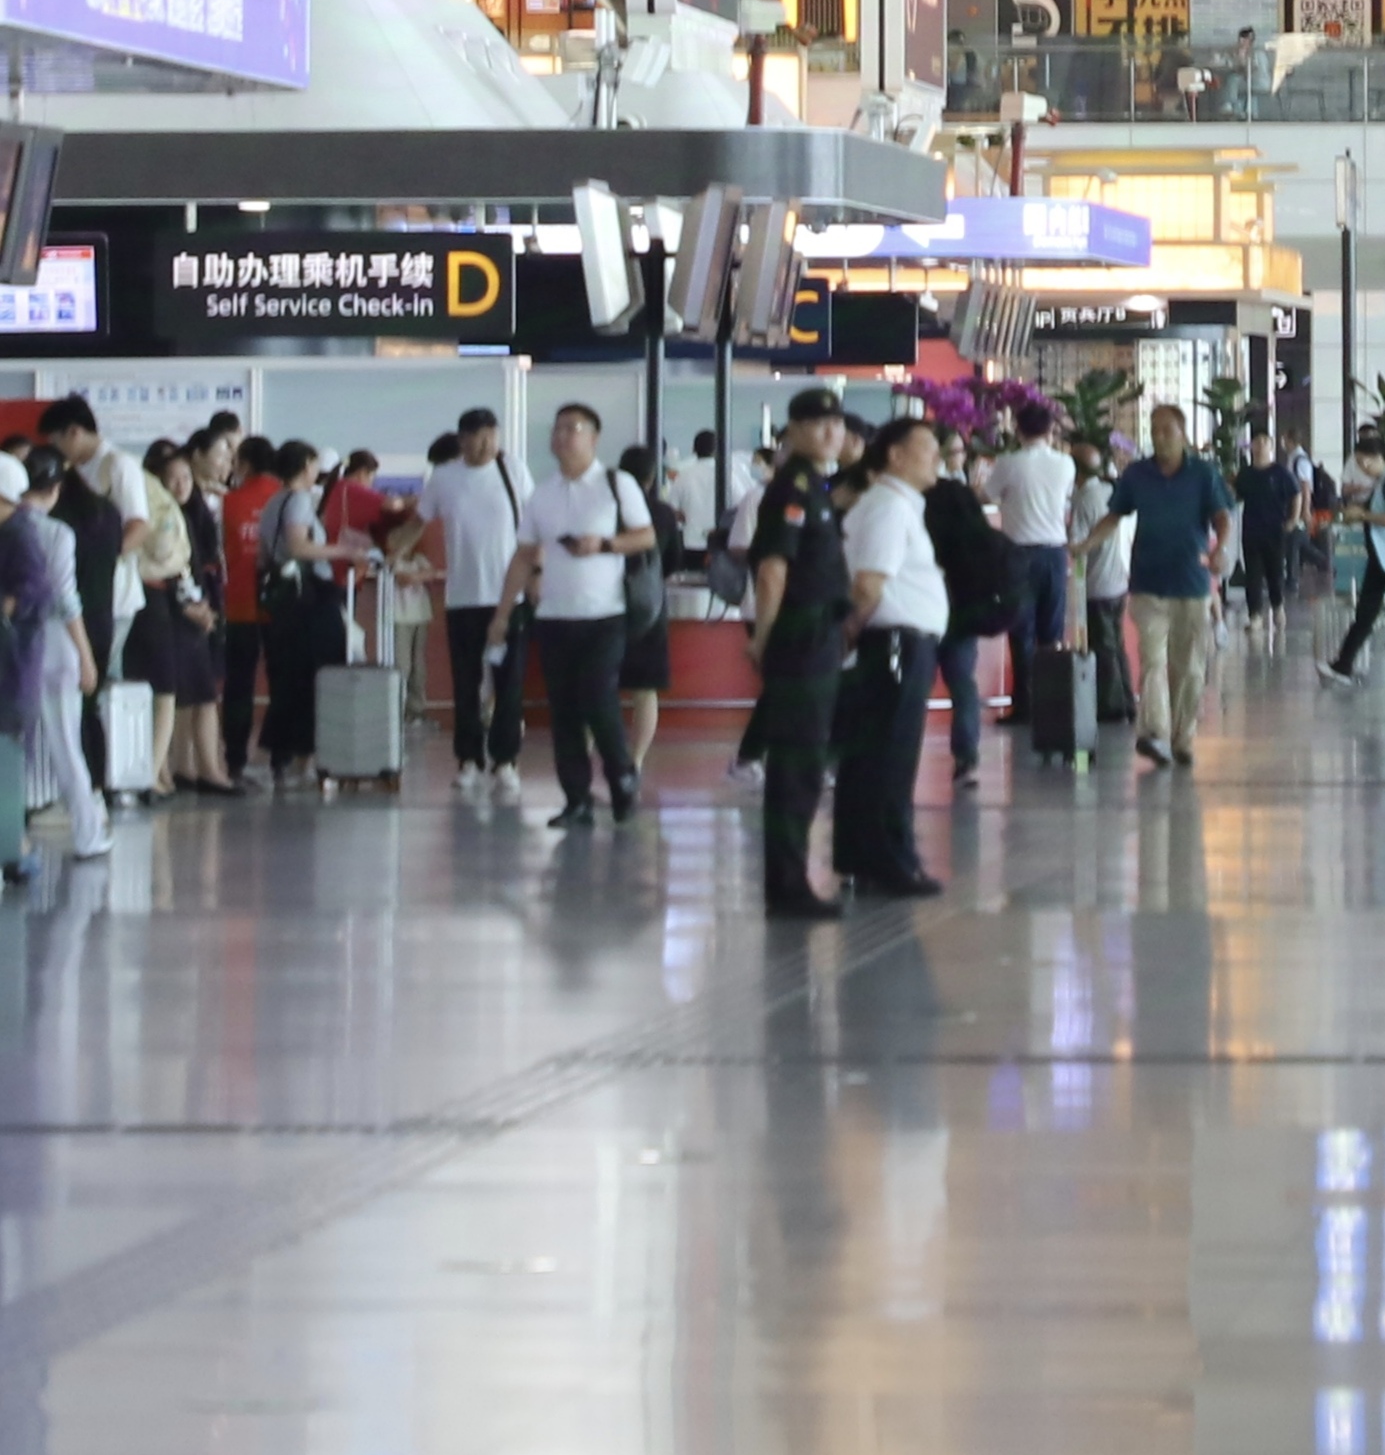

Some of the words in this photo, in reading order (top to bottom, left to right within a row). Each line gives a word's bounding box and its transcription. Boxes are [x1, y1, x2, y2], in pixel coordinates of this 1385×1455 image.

[172, 252, 434, 289] 自助办理乘机手续
[448, 250, 500, 317] D
[206, 293, 248, 318] Self
[254, 293, 331, 318] Service
[338, 293, 434, 318] Check-in
